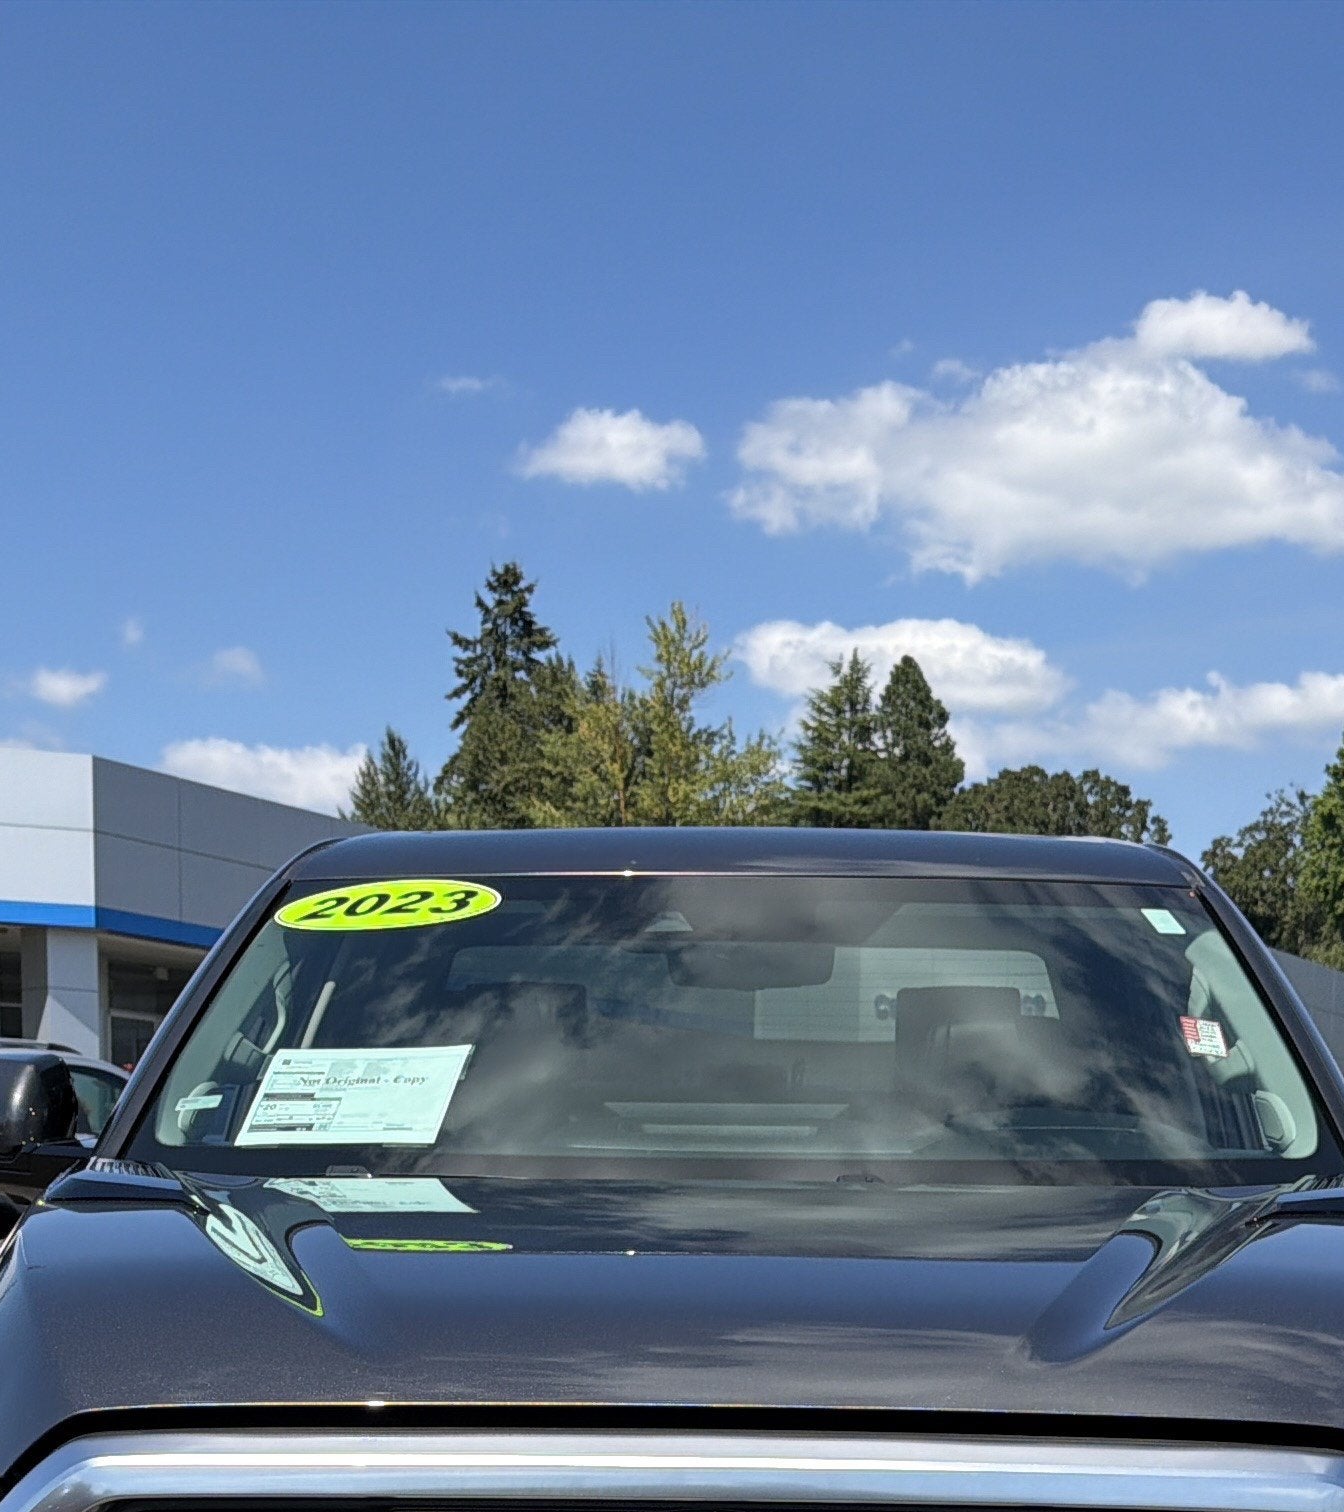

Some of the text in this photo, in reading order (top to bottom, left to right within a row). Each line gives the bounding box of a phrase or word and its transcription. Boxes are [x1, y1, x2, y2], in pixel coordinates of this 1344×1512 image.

[293, 889, 479, 922] 2023
[325, 1075, 381, 1087] Original
[393, 1074, 428, 1086] Copy
